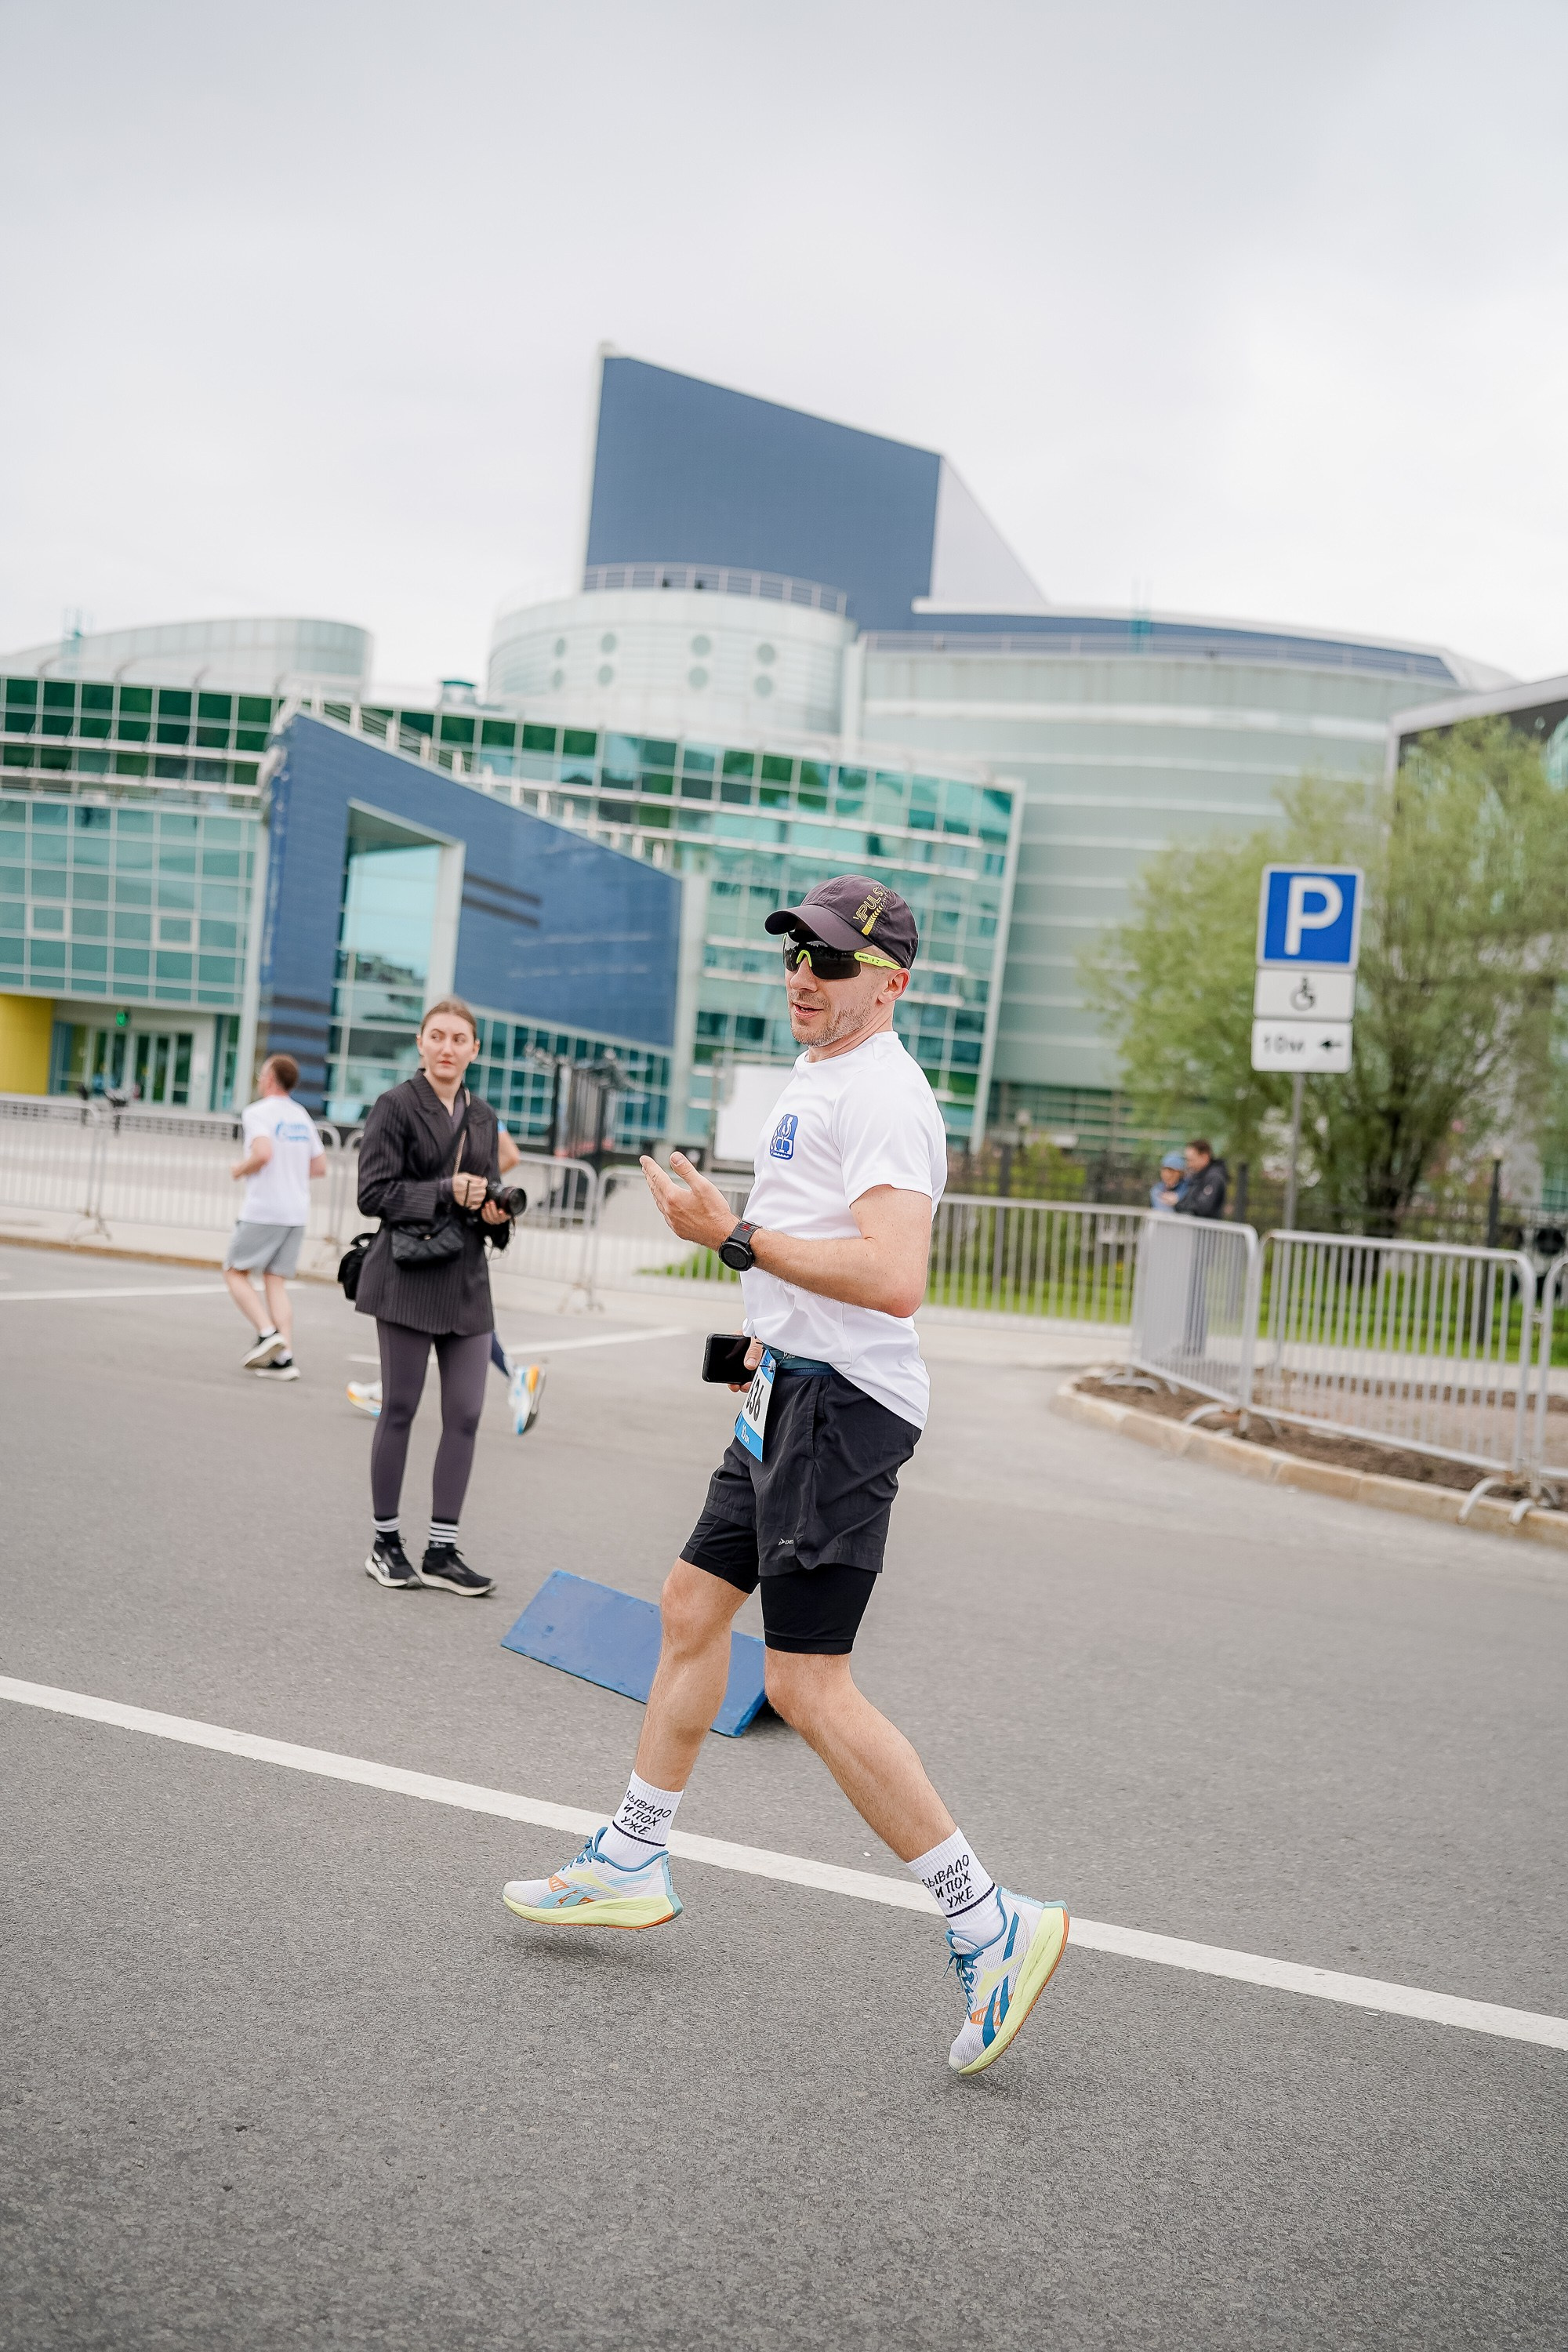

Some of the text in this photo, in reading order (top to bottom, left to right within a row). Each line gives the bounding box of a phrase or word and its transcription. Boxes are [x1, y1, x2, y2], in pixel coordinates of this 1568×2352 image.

[1283, 876, 1344, 956] P
[620, 1816, 652, 1835] УЖЕ
[623, 1803, 661, 1827] И ПОХ
[935, 1870, 971, 1899] И ПОХ
[946, 1886, 975, 1908] УЖЕ
